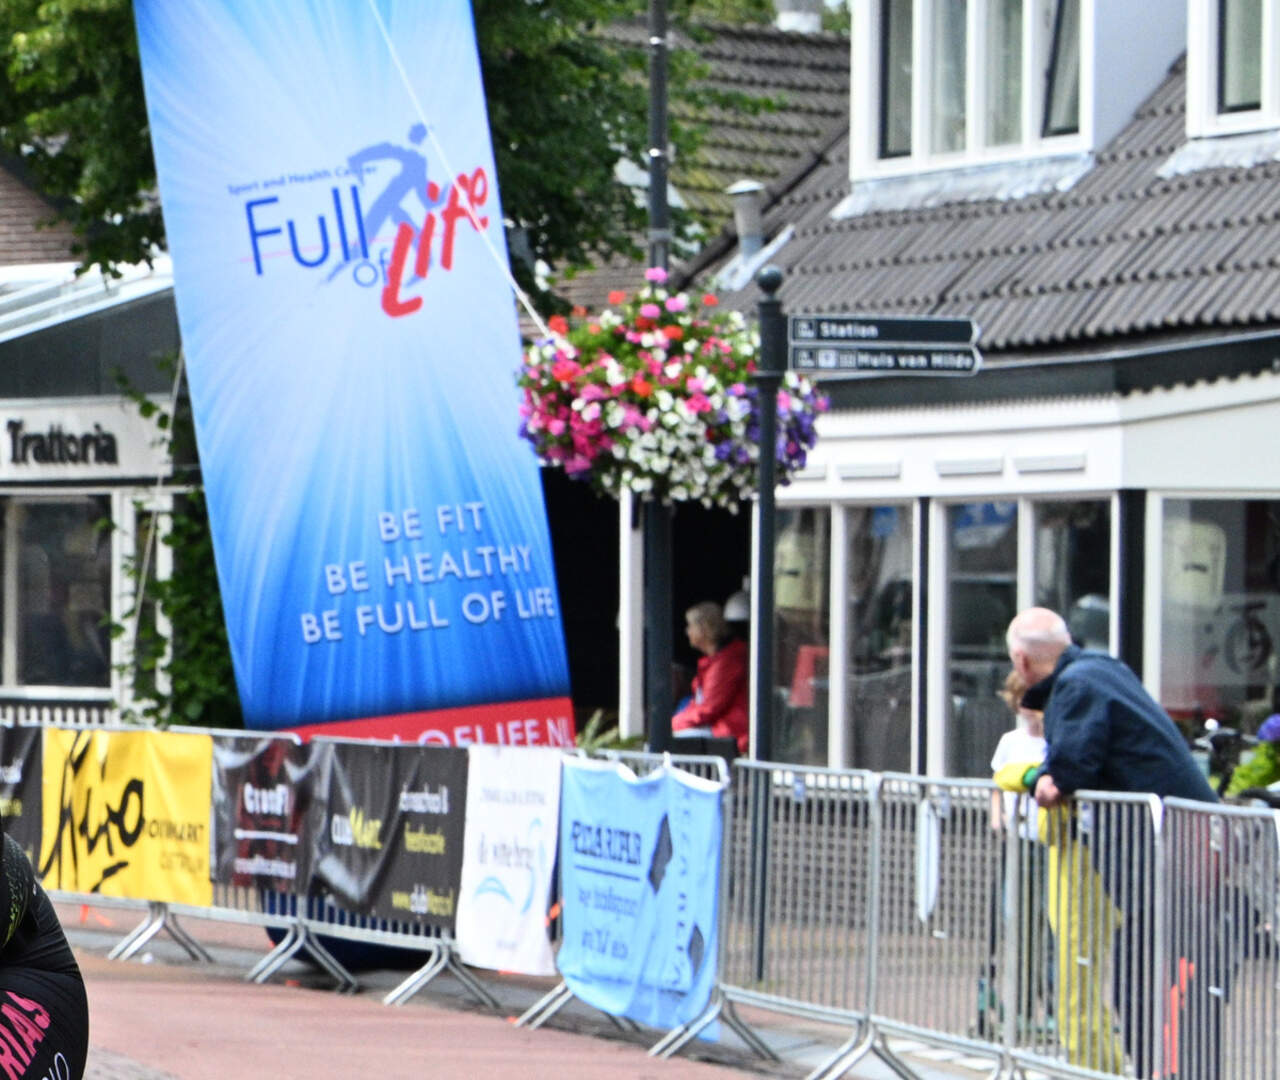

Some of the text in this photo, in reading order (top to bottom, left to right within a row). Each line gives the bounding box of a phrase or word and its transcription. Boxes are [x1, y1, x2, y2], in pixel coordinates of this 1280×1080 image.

[246, 185, 369, 276] Full
[381, 166, 490, 318] Life
[353, 247, 390, 288] of
[819, 321, 879, 338] Station
[857, 351, 895, 368] Huis
[897, 355, 928, 368] van
[6, 418, 120, 466] Trattoria
[379, 501, 486, 542] BE FIT
[325, 545, 534, 596] BE HEALTHY
[300, 586, 557, 644] BE FULL OF LIFE
